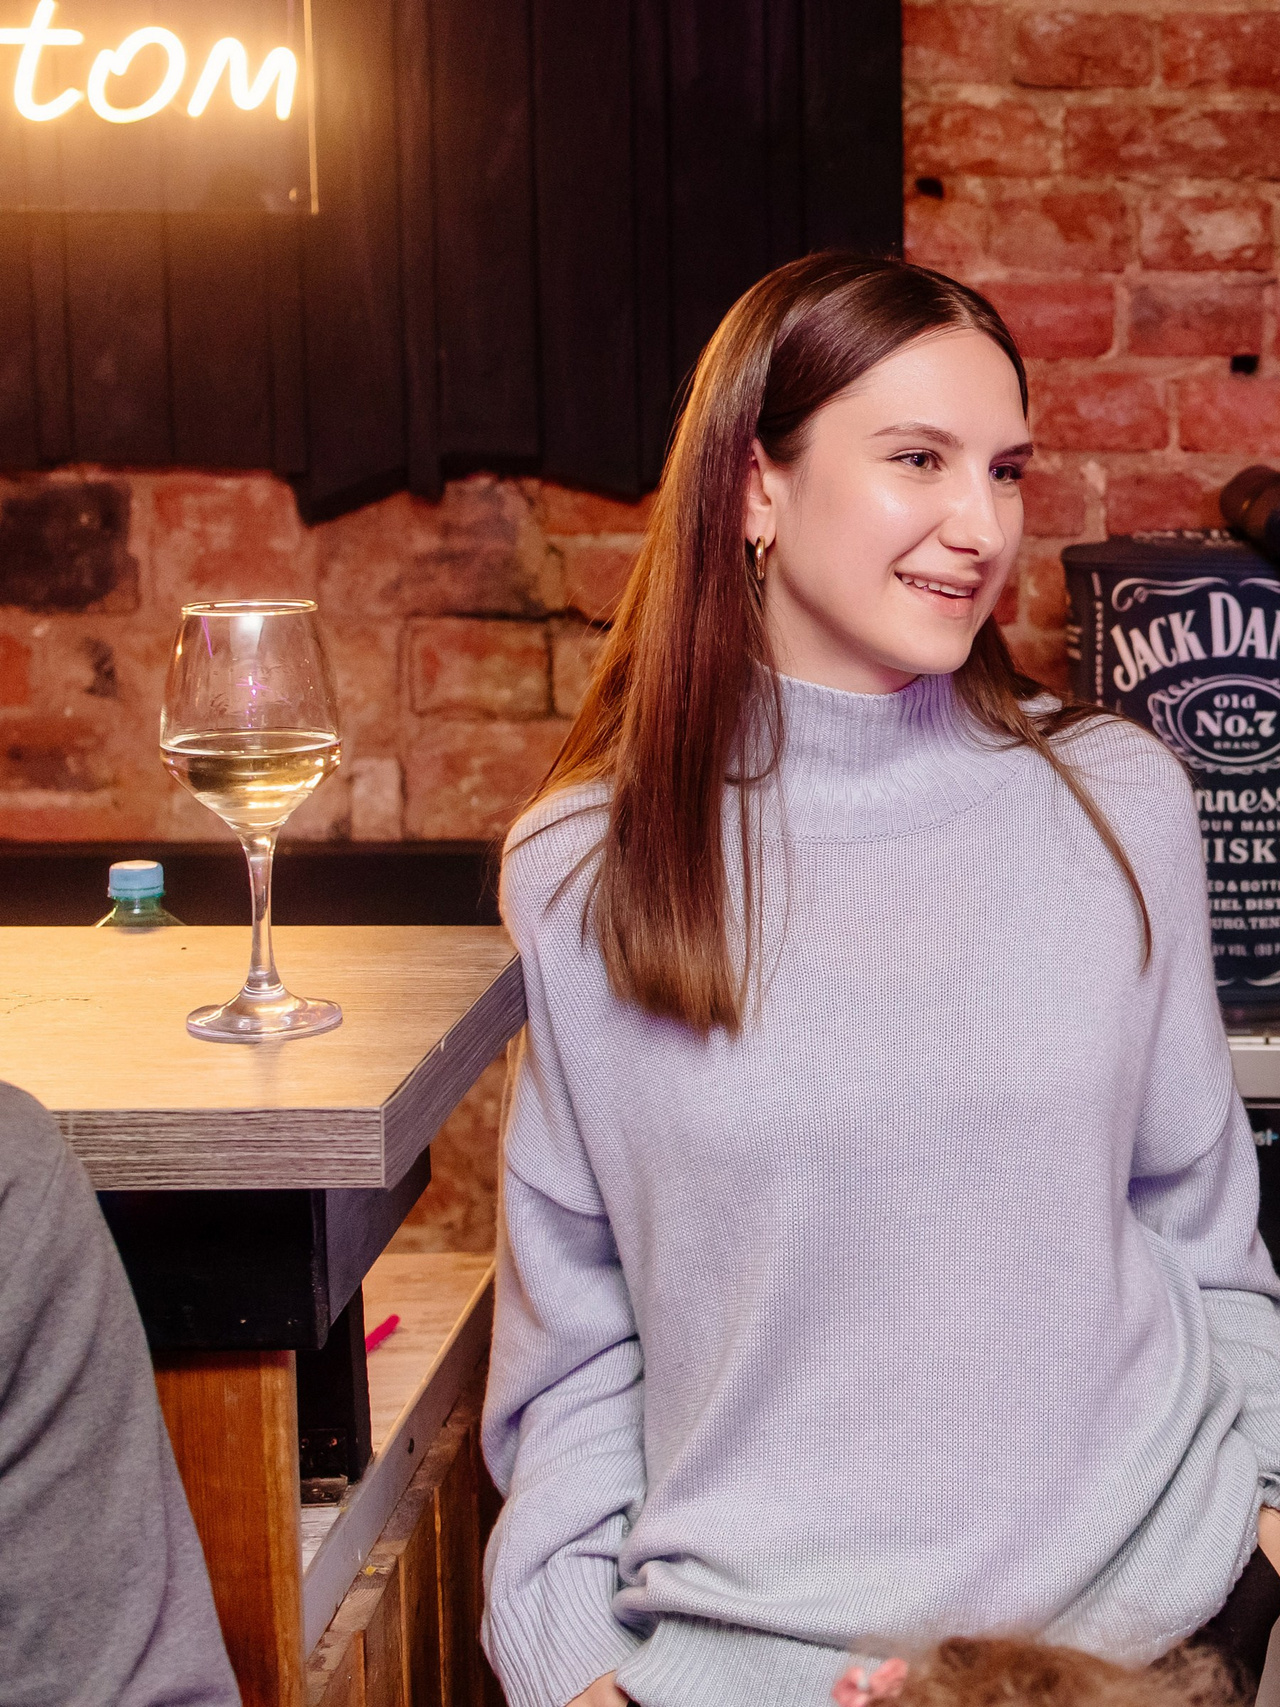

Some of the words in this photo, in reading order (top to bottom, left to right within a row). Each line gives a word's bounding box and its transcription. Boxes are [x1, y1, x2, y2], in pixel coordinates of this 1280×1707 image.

[1110, 609, 1207, 692] JACK
[1213, 692, 1256, 710] Old
[1213, 739, 1260, 750] BRAND
